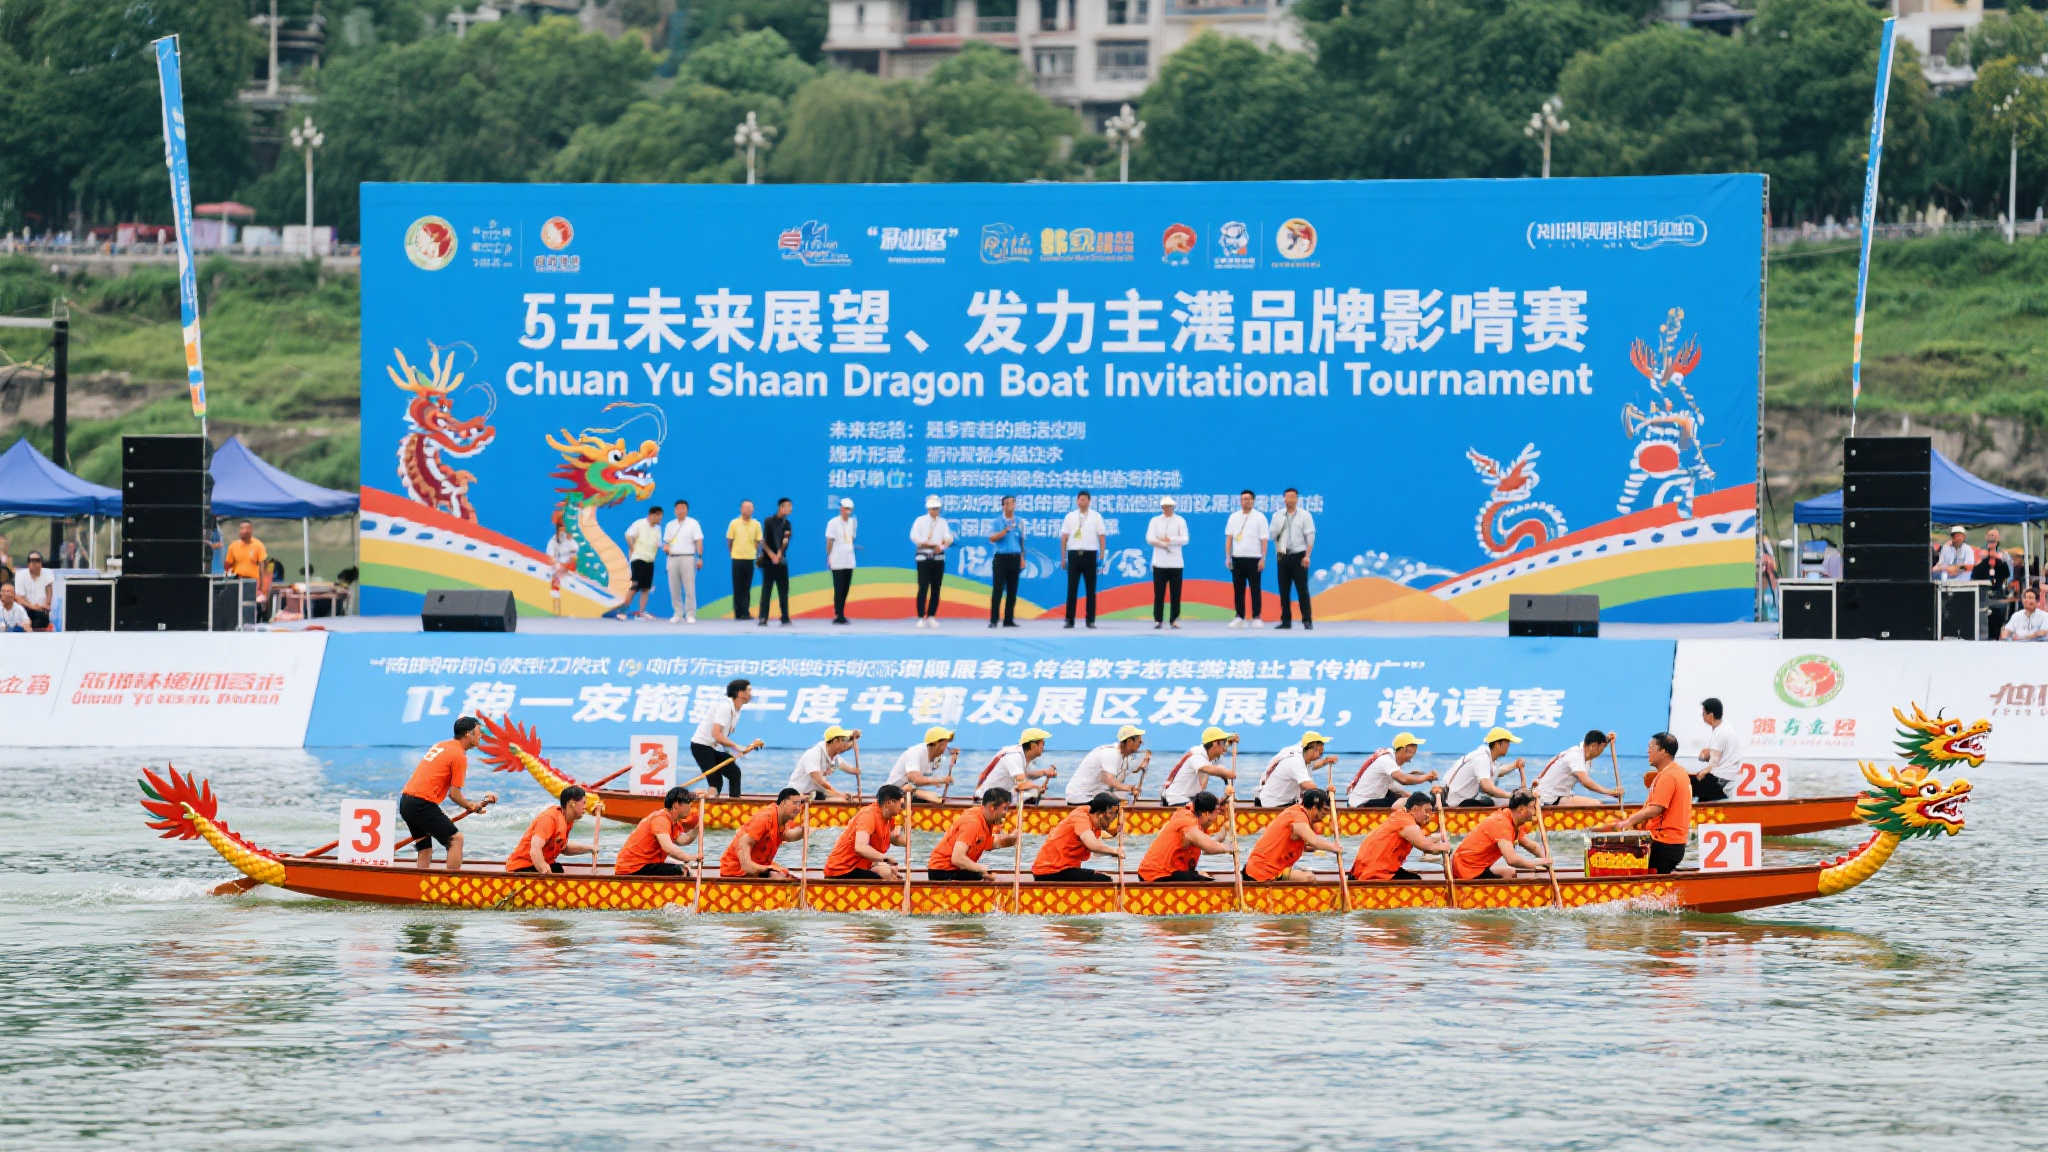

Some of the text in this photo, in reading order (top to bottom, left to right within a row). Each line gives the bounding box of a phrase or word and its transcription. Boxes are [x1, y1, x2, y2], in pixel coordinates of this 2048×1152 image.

[506, 361, 1593, 406] Chuan Yu Shaan Dragon Boat Invitational Tournament
[1736, 763, 1782, 797] 23
[352, 809, 381, 853] 3
